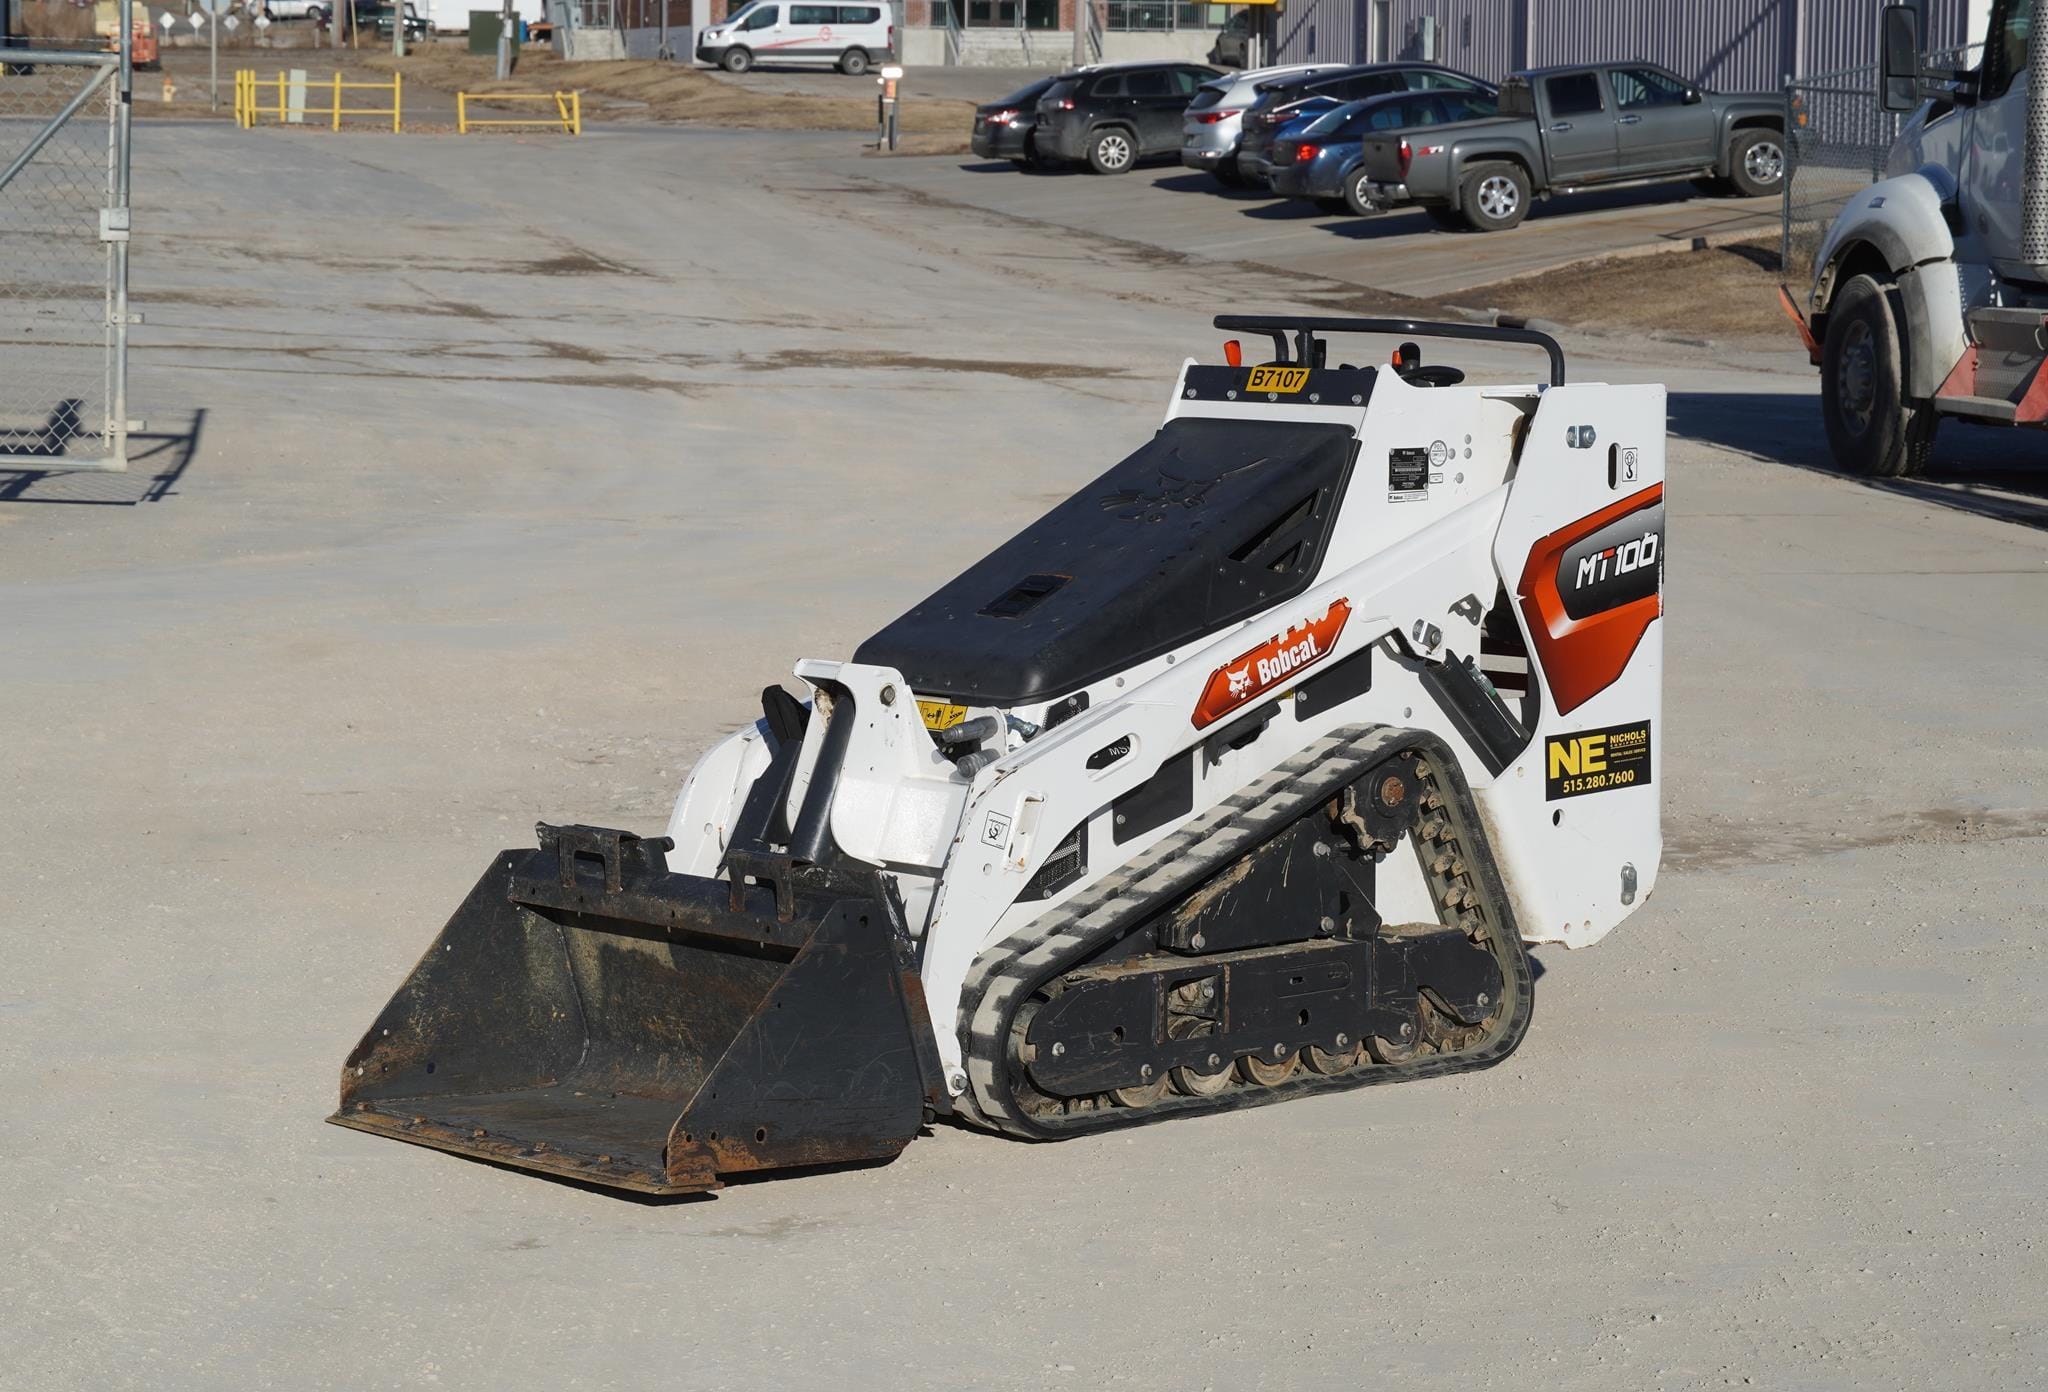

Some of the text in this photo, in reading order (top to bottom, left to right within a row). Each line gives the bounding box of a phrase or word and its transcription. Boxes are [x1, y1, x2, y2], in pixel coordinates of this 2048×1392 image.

[1251, 370, 1306, 388] B7107
[1575, 533, 1659, 590] MT100
[1256, 632, 1318, 686] Bobcat
[1610, 730, 1646, 744] NICHOLS
[1549, 734, 1607, 780] NE
[1563, 769, 1635, 793] 515.280.7600
